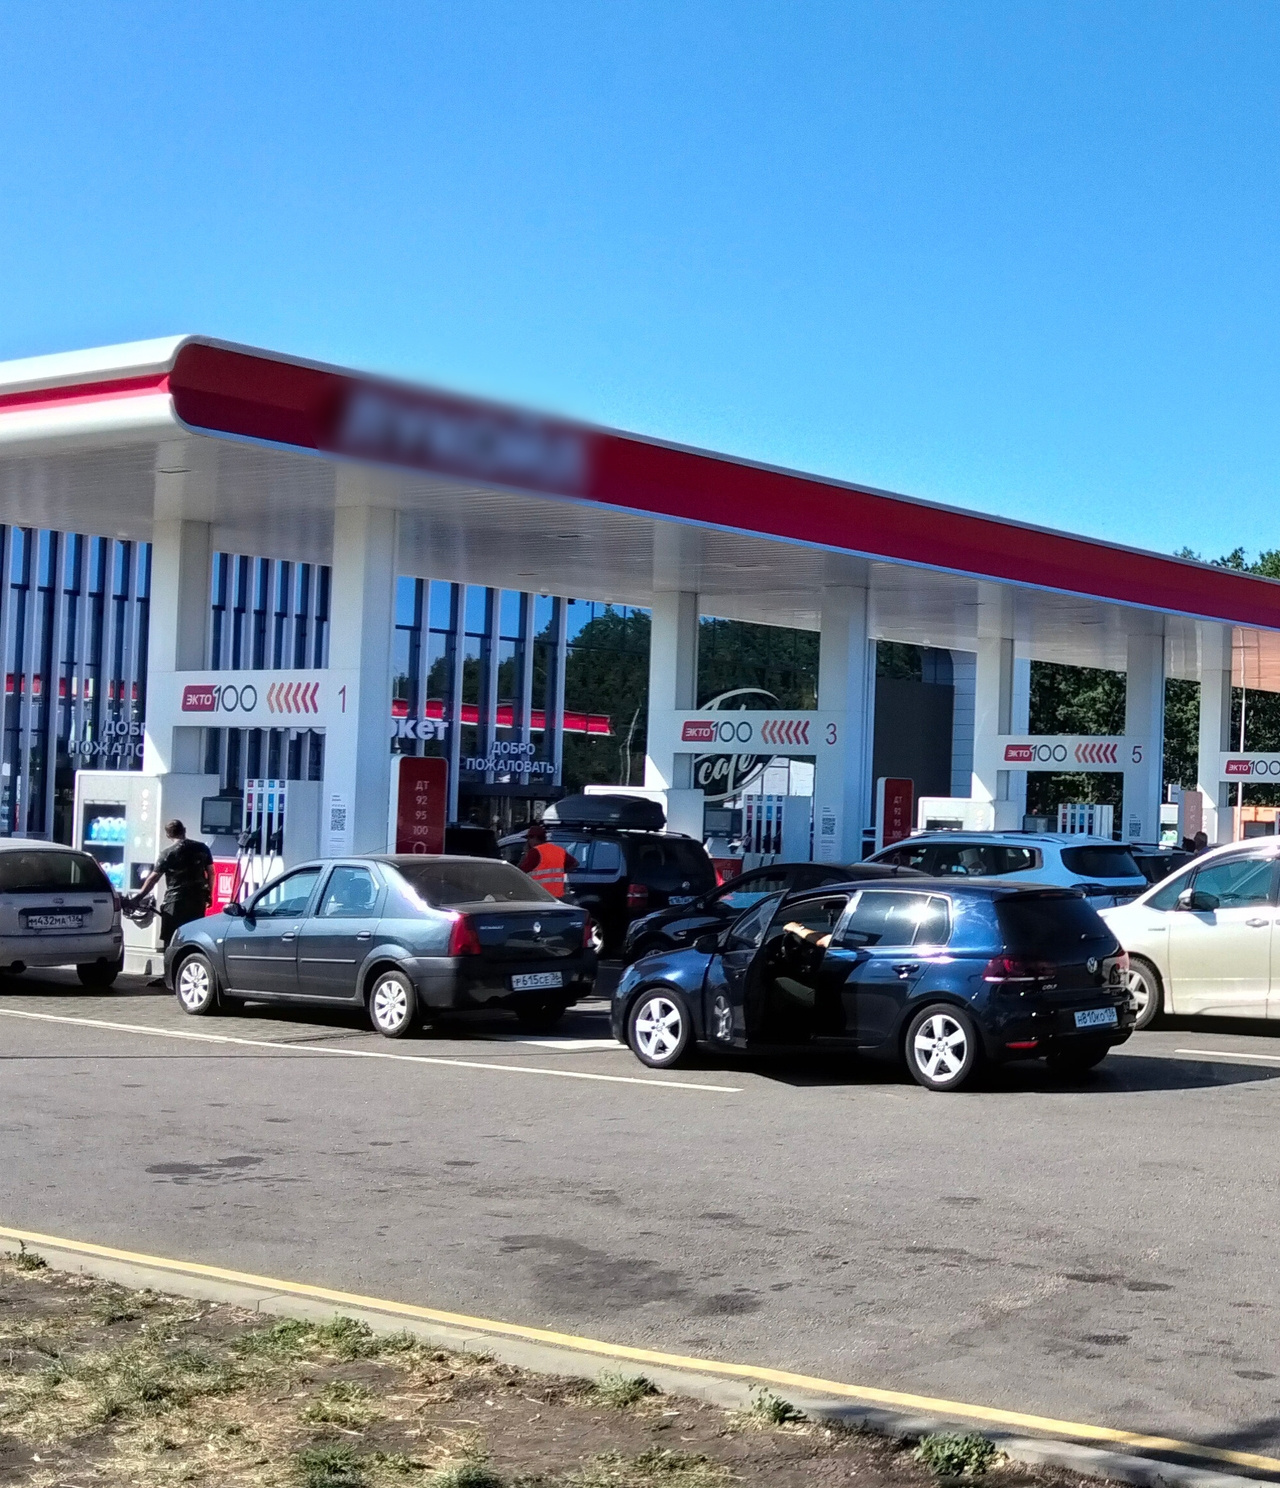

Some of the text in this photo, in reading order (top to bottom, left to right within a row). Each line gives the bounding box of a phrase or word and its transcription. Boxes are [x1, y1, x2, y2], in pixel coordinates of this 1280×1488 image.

[185, 684, 347, 714] ЭКТО 100 1
[685, 720, 838, 745] ЭКТО 100 3
[491, 740, 536, 756] ДОБРО
[1007, 744, 1143, 764] ЭКТО 100 5
[466, 757, 558, 774] ПОЖАЛОВАТЬ!
[1228, 763, 1249, 772] ЭКТО
[415, 780, 430, 792] ДТ
[415, 795, 428, 805] 92
[415, 811, 428, 820] 95
[412, 825, 429, 835] 100
